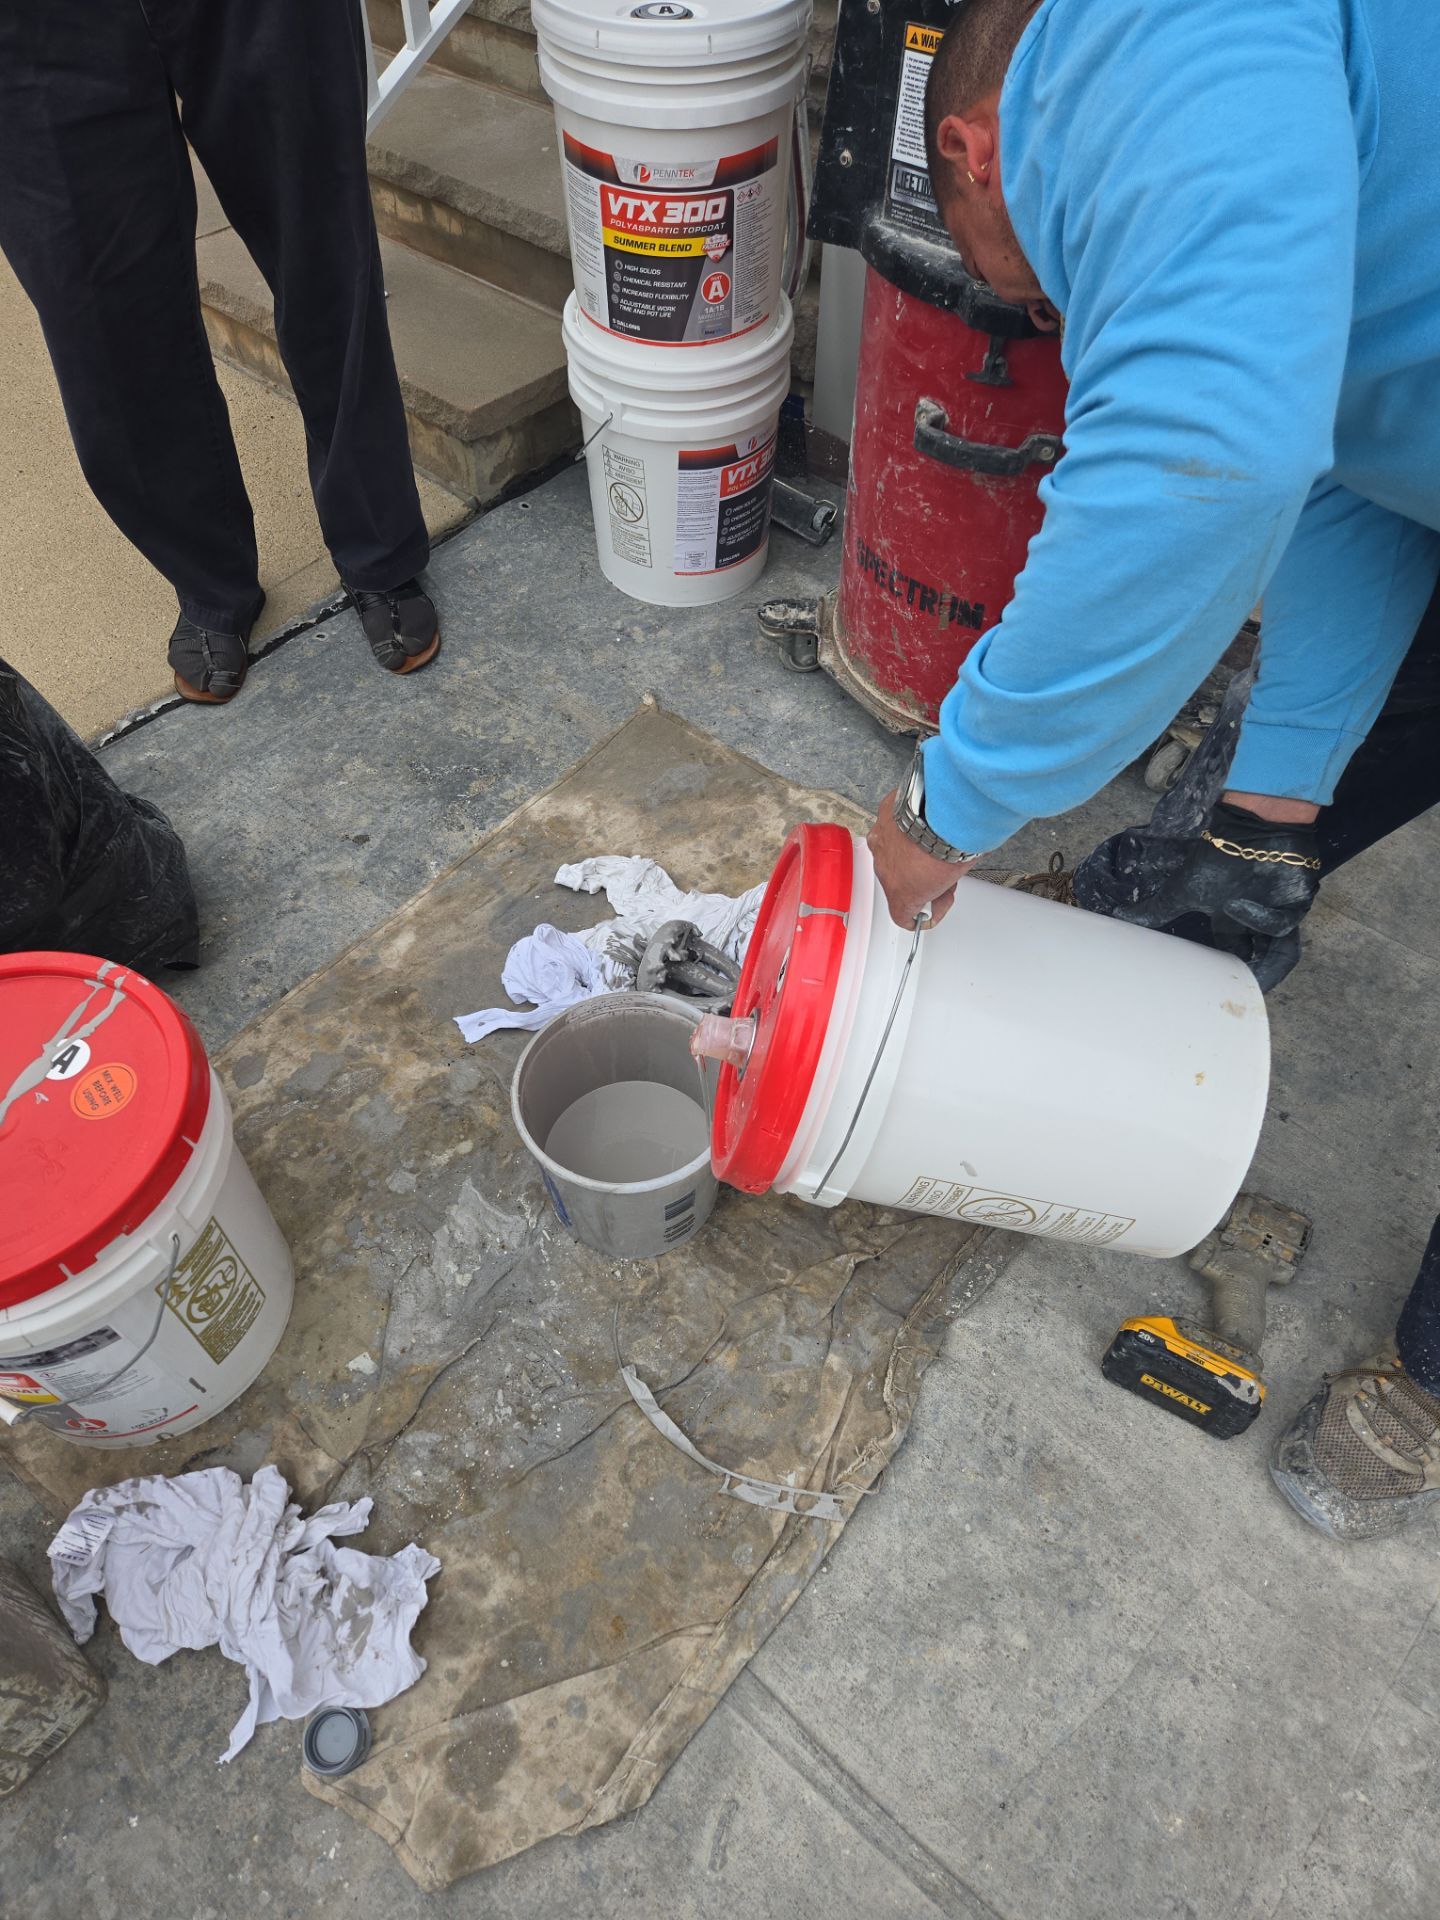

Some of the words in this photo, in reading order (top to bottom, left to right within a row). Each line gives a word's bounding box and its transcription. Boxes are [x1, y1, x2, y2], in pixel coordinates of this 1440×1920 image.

[659, 6, 674, 14] A
[653, 168, 695, 178] PENNTEK
[608, 192, 660, 223] VTX
[662, 197, 727, 223] 300
[610, 218, 679, 234] POLYASPARTIC
[683, 222, 726, 234] TOPCOAT
[613, 235, 656, 251] SUMMER
[658, 243, 692, 252] BLEND
[624, 264, 638, 272] HIGH
[623, 276, 652, 287] CHEMICAL
[708, 280, 725, 300] A
[622, 288, 654, 298] INCREASED
[619, 304, 632, 312] TIME
[620, 298, 656, 310] ADJUSTABLE
[856, 537, 985, 630] SPECTRUM
[51, 1044, 81, 1075] A
[92, 1080, 112, 1106] BEFORE
[102, 1070, 114, 1086] MIX
[110, 1084, 124, 1103] WELL
[82, 1088, 100, 1111] USING
[1140, 1373, 1213, 1415] DEWALT
